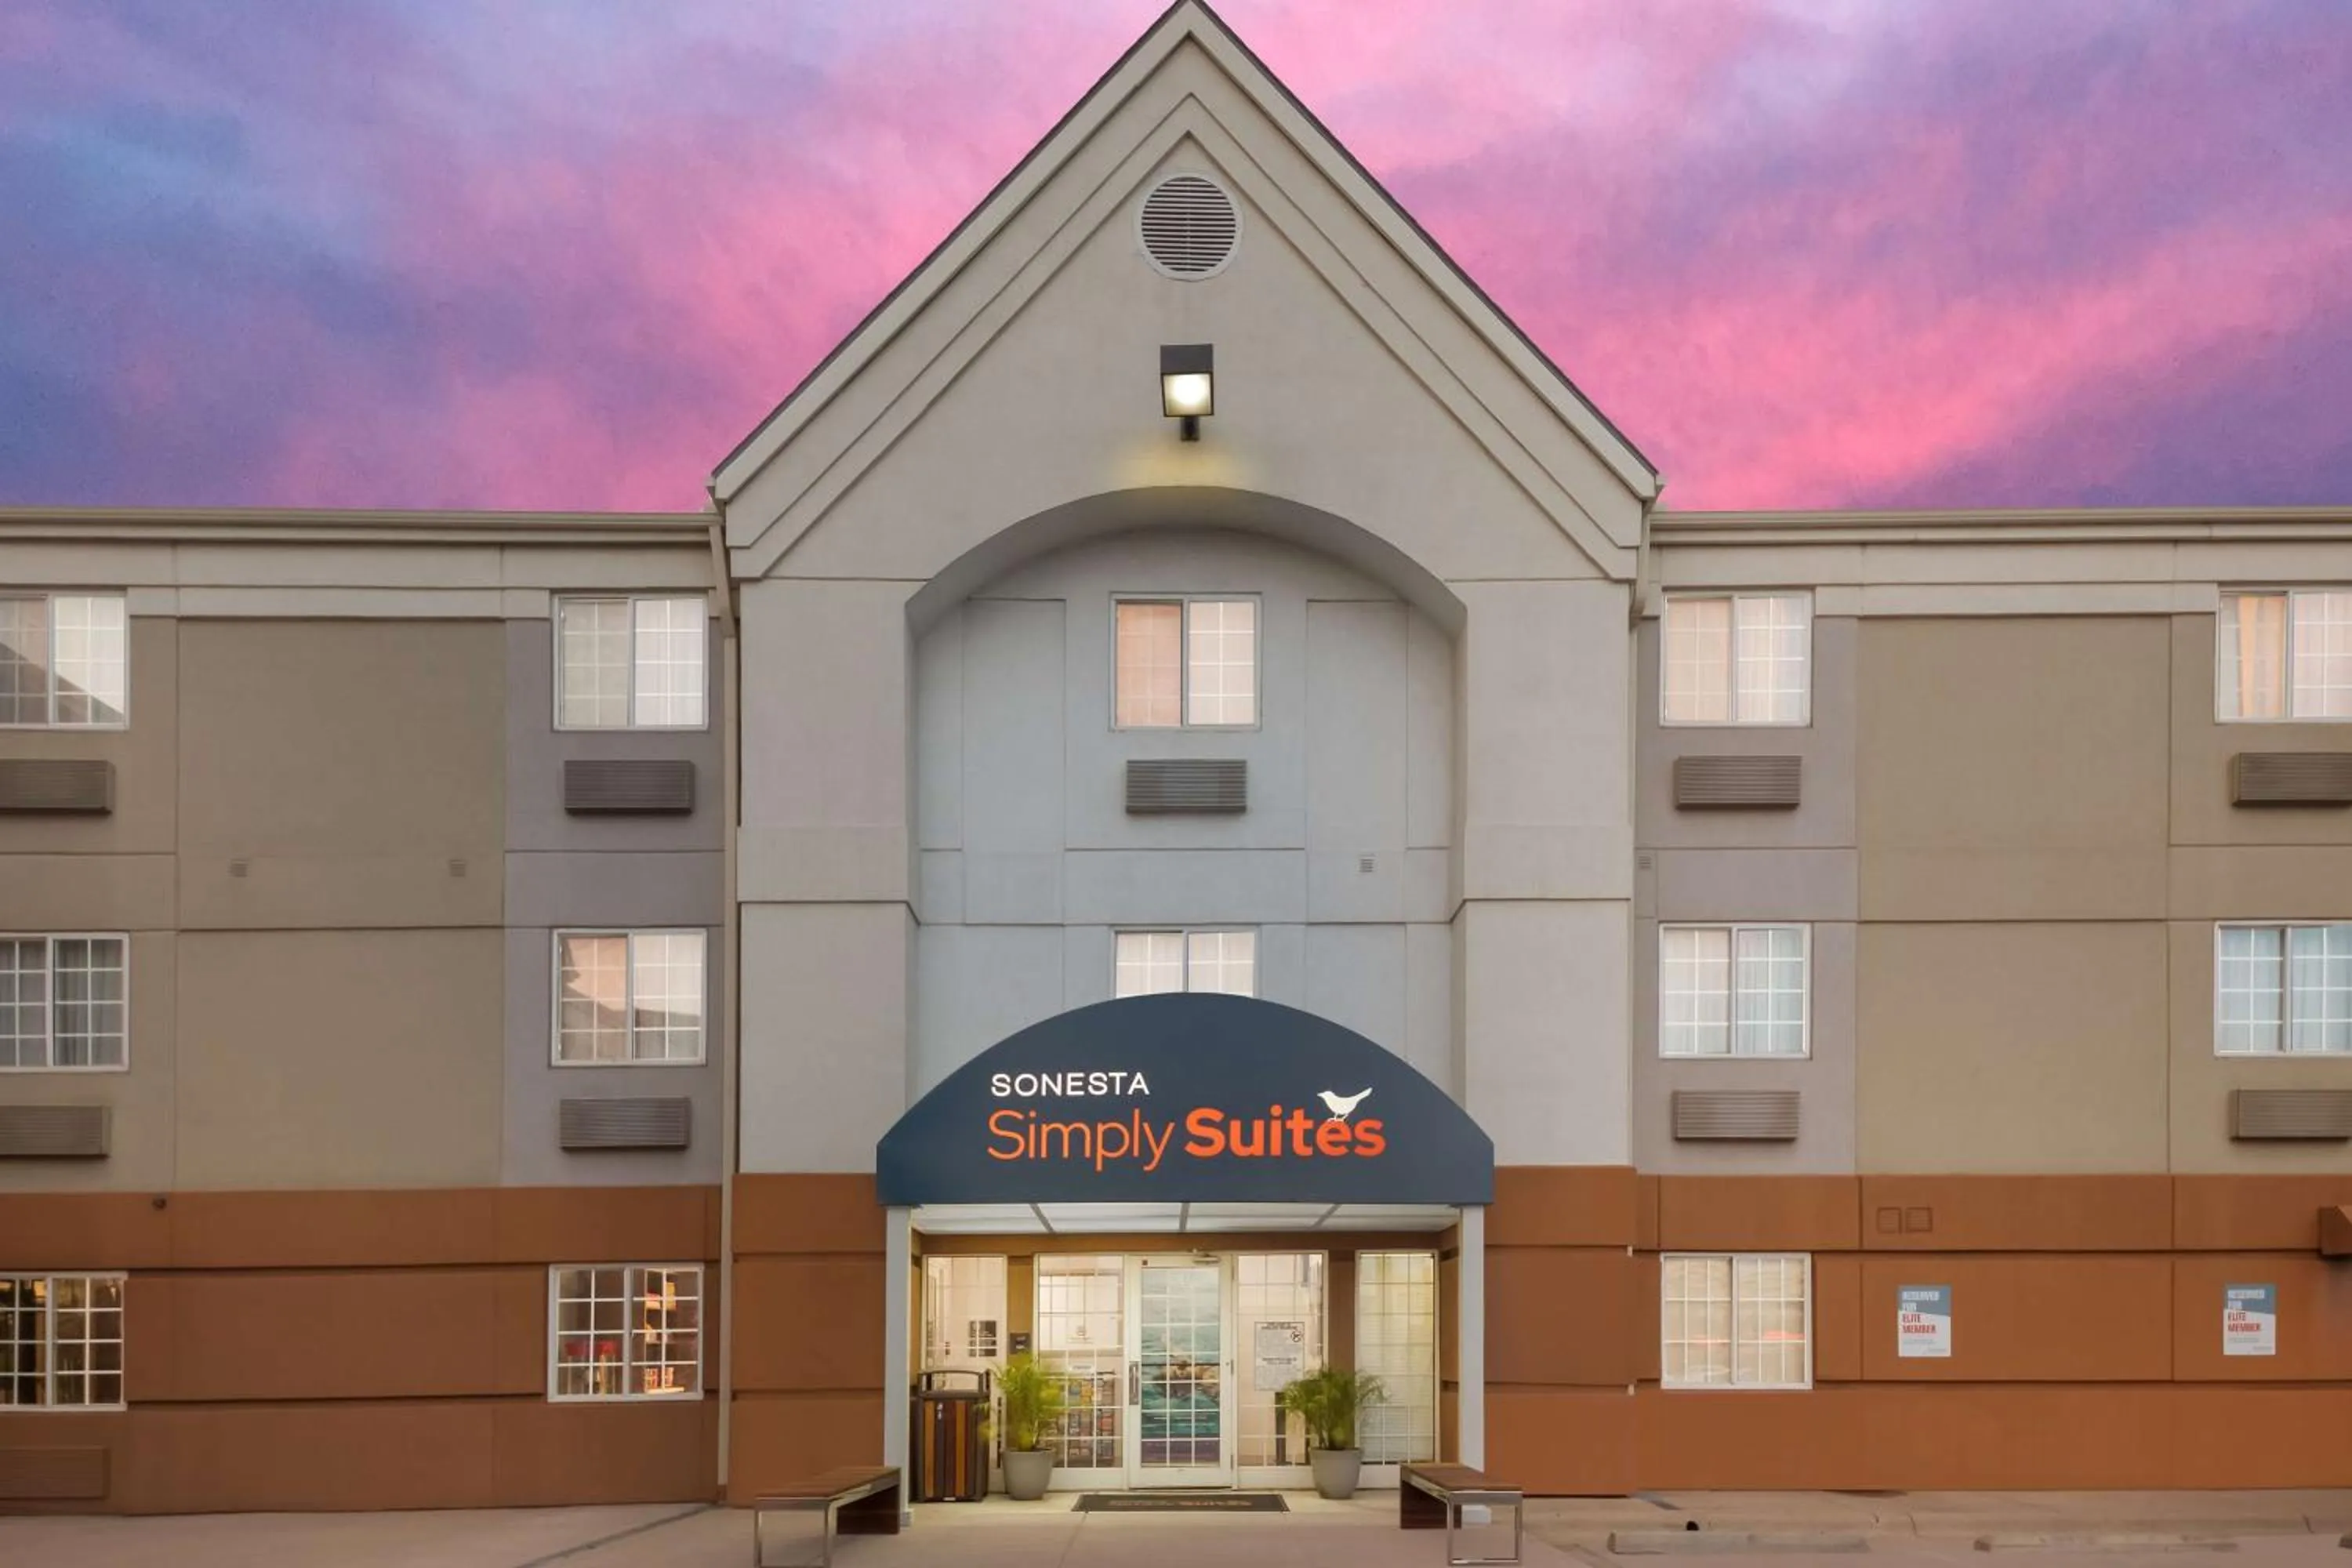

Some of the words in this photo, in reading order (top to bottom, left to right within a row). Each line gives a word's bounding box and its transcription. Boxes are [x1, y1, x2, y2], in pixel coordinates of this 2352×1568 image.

[990, 1072, 1150, 1097] SONESTA
[987, 1109, 1175, 1172] Simply
[1184, 1103, 1387, 1159] Suites
[1902, 1313, 1921, 1323] ELITE
[2228, 1312, 2246, 1321] ELITE
[1902, 1324, 1936, 1334] MEMBER
